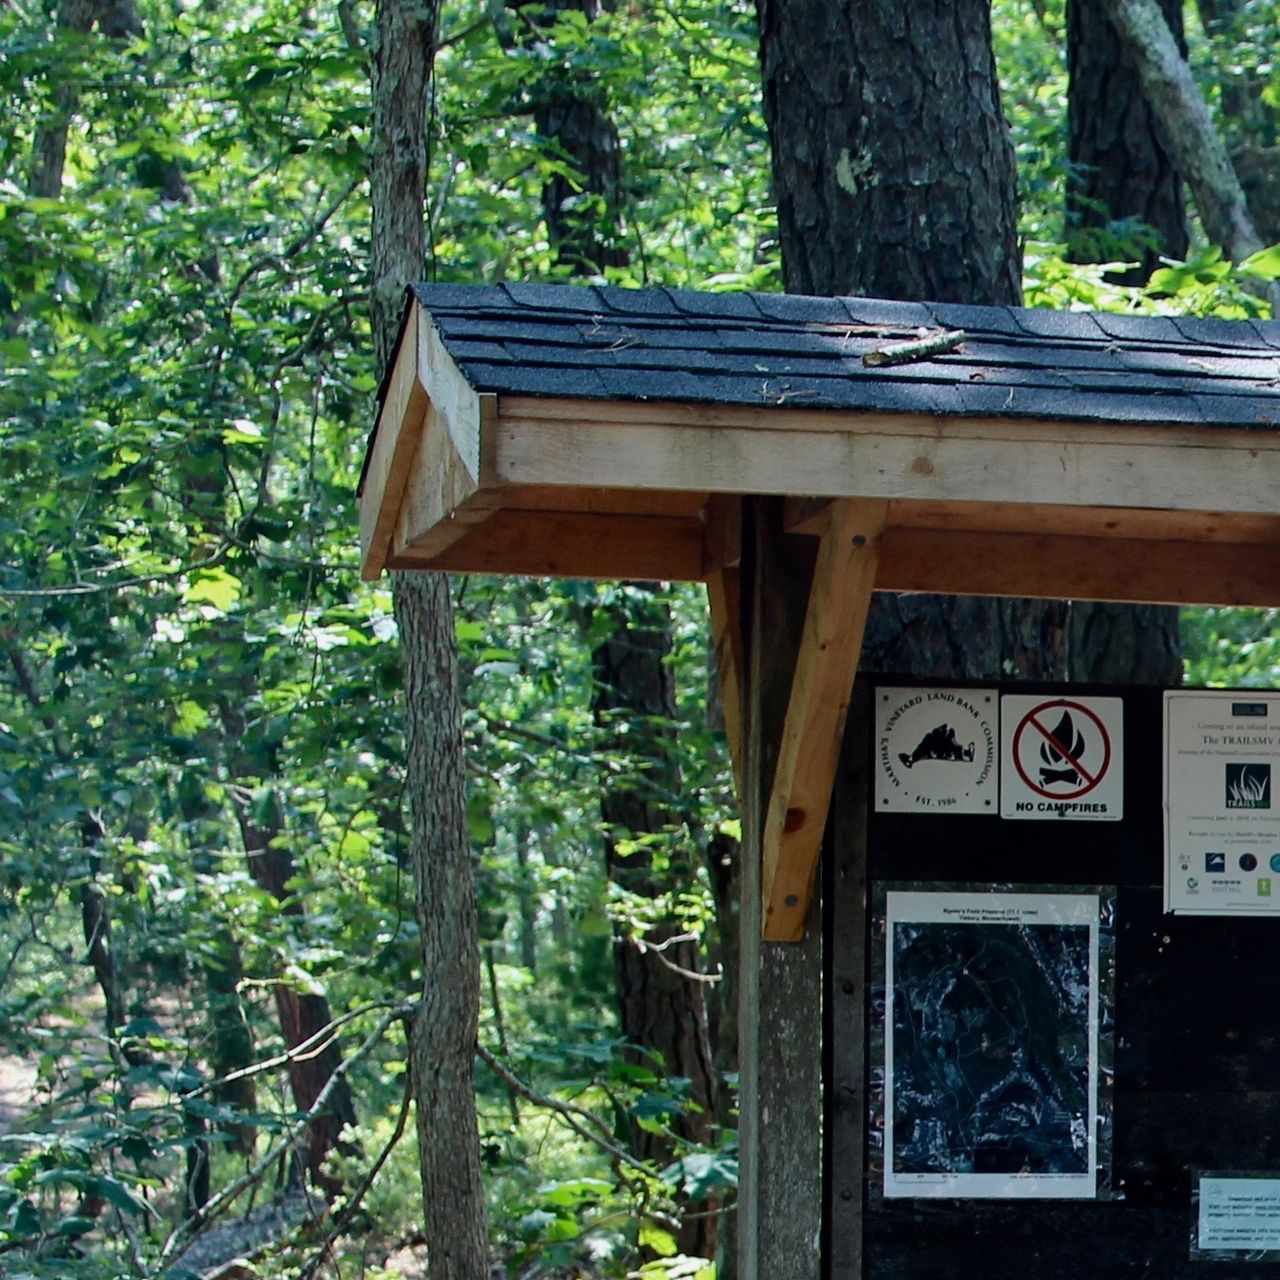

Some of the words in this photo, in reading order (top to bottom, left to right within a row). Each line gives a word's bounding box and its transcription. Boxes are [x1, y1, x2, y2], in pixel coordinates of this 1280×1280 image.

[885, 696, 923, 731] VINEYARD
[927, 693, 955, 702] LAND
[956, 698, 979, 719] BANK
[975, 721, 994, 787] COMMISSION
[1202, 736, 1219, 745] The
[1222, 736, 1273, 746] TRAILSMV
[916, 795, 935, 807] EST.
[1228, 800, 1255, 808] TRAILS
[1016, 802, 1034, 812] NO
[1037, 802, 1108, 813] CAMPFIRES
